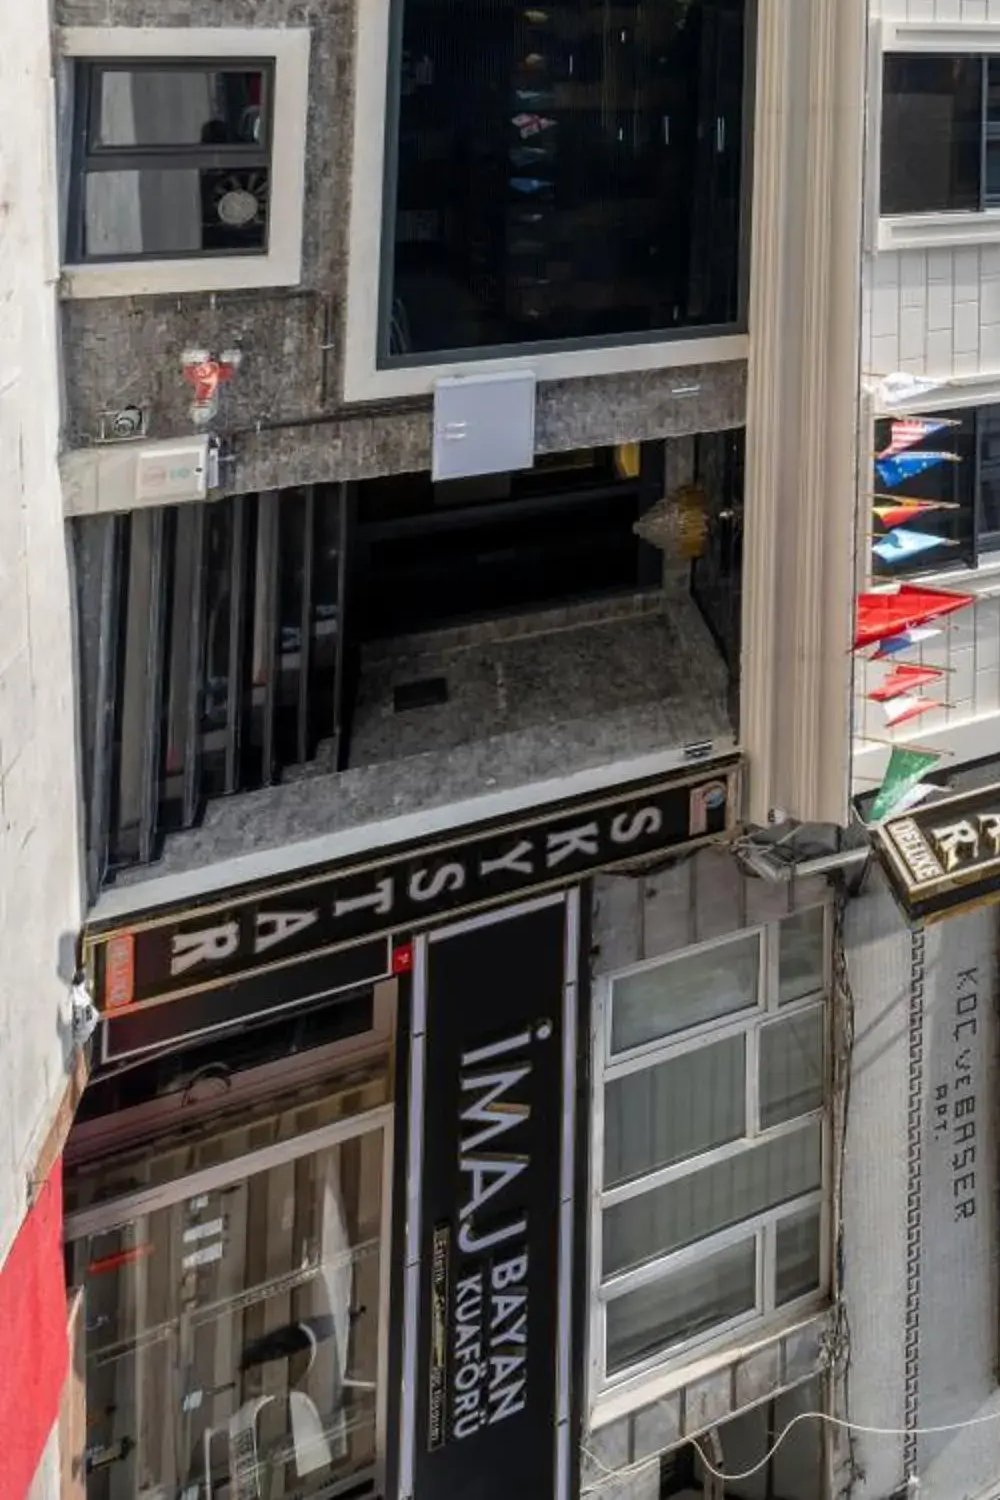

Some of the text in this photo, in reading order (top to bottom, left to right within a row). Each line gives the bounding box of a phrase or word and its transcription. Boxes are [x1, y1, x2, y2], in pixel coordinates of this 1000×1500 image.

[170, 805, 663, 976] SKYSTAR
[887, 820, 942, 881] DELUXE
[953, 966, 979, 1041] KOÇ
[458, 1019, 552, 1253] İMAJ
[934, 1084, 948, 1141] APT.
[952, 1095, 977, 1223] BAŞER
[451, 1273, 487, 1439] KUAFÖRÜ
[487, 1253, 528, 1427] BAYAN
